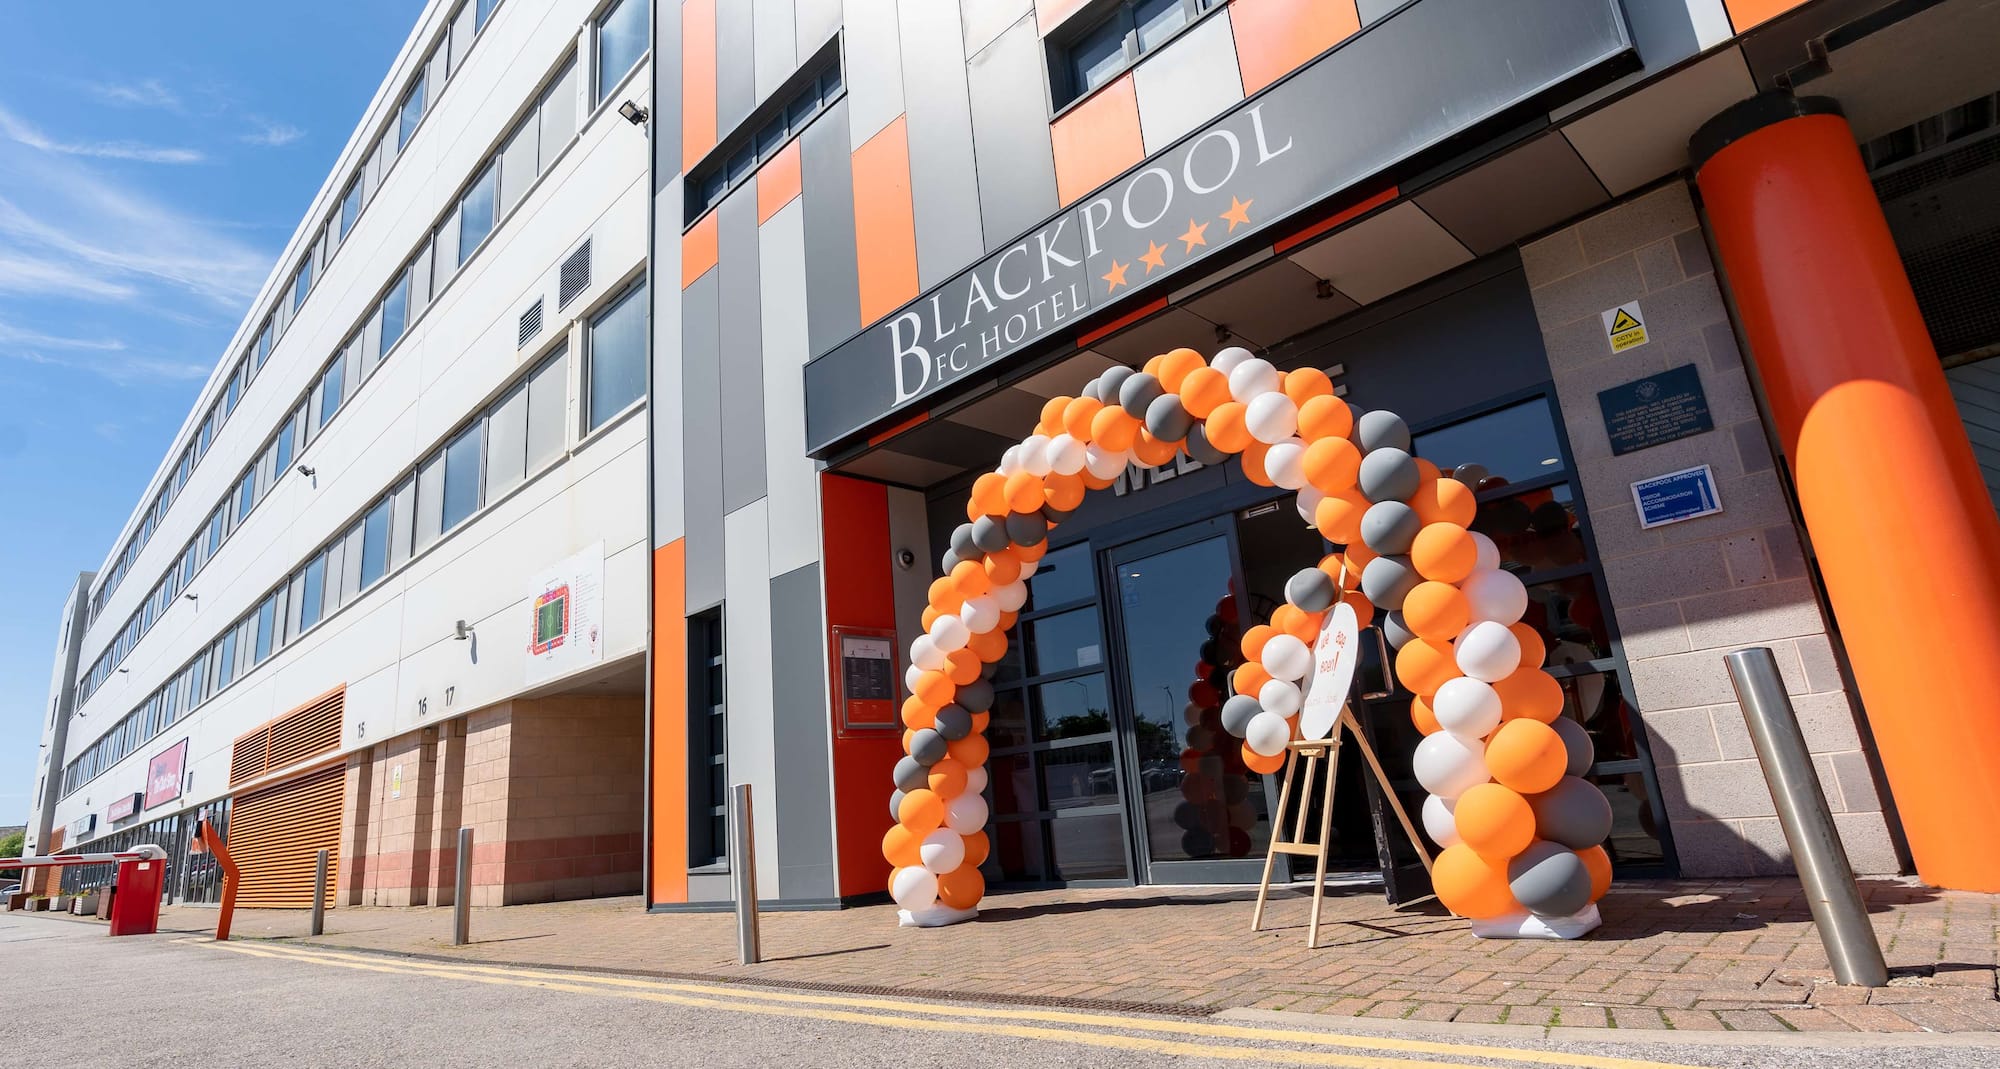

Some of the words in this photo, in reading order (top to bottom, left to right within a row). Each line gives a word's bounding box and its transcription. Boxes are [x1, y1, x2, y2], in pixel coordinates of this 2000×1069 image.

[885, 103, 1292, 407] BLACKPOOL
[936, 343, 968, 381] FC
[981, 284, 1087, 359] HOTEL
[1615, 332, 1633, 342] CCTV
[1615, 336, 1644, 349] operation
[1638, 479, 1671, 490] BLACKPOOL
[1673, 470, 1704, 481] APPROVED
[1641, 492, 1660, 501] VISITOR
[1643, 490, 1693, 506] ACCOMMODATION
[1644, 503, 1665, 511] SCHEME
[446, 686, 455, 707] 17
[418, 697, 427, 717] 16
[358, 721, 365, 739] 15
